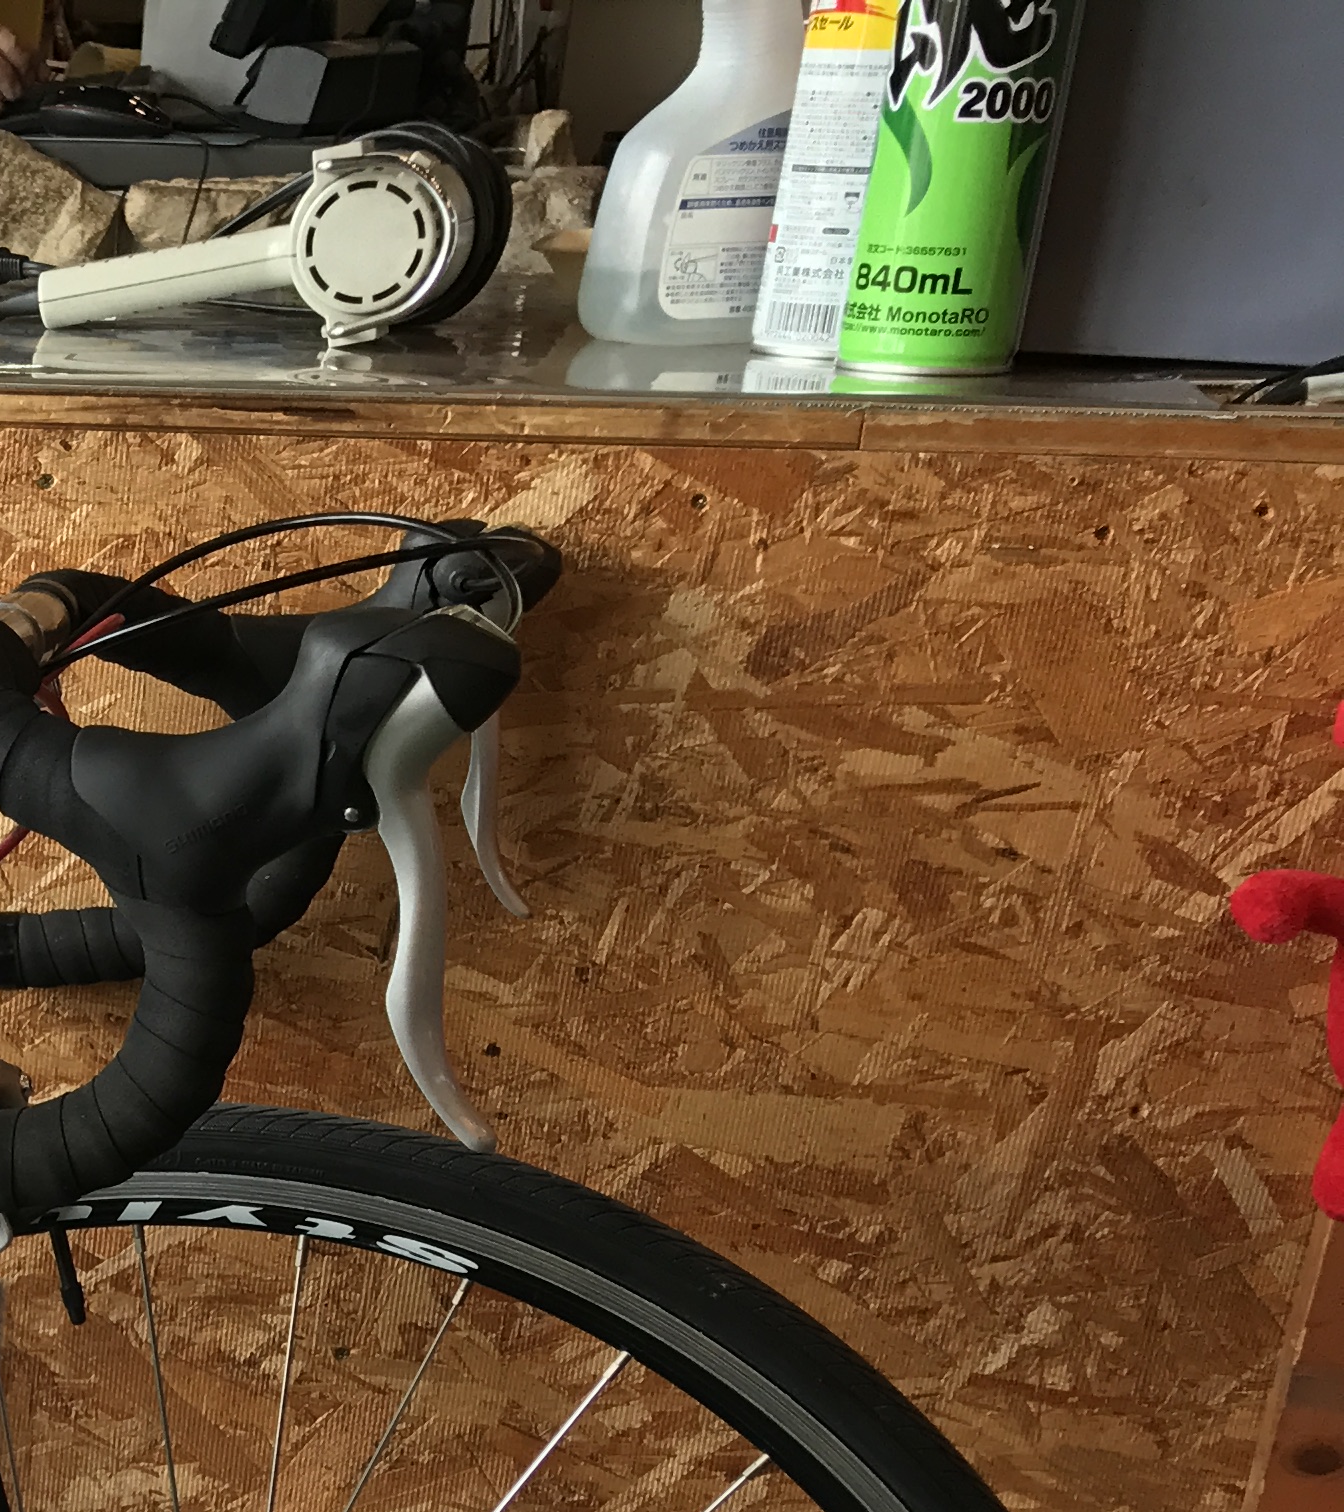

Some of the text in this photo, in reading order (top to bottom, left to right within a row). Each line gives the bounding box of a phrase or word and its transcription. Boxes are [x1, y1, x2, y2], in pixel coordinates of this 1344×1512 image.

[957, 79, 1054, 122] 2000
[855, 262, 974, 296] 840mL
[886, 305, 990, 326] MonotaRO
